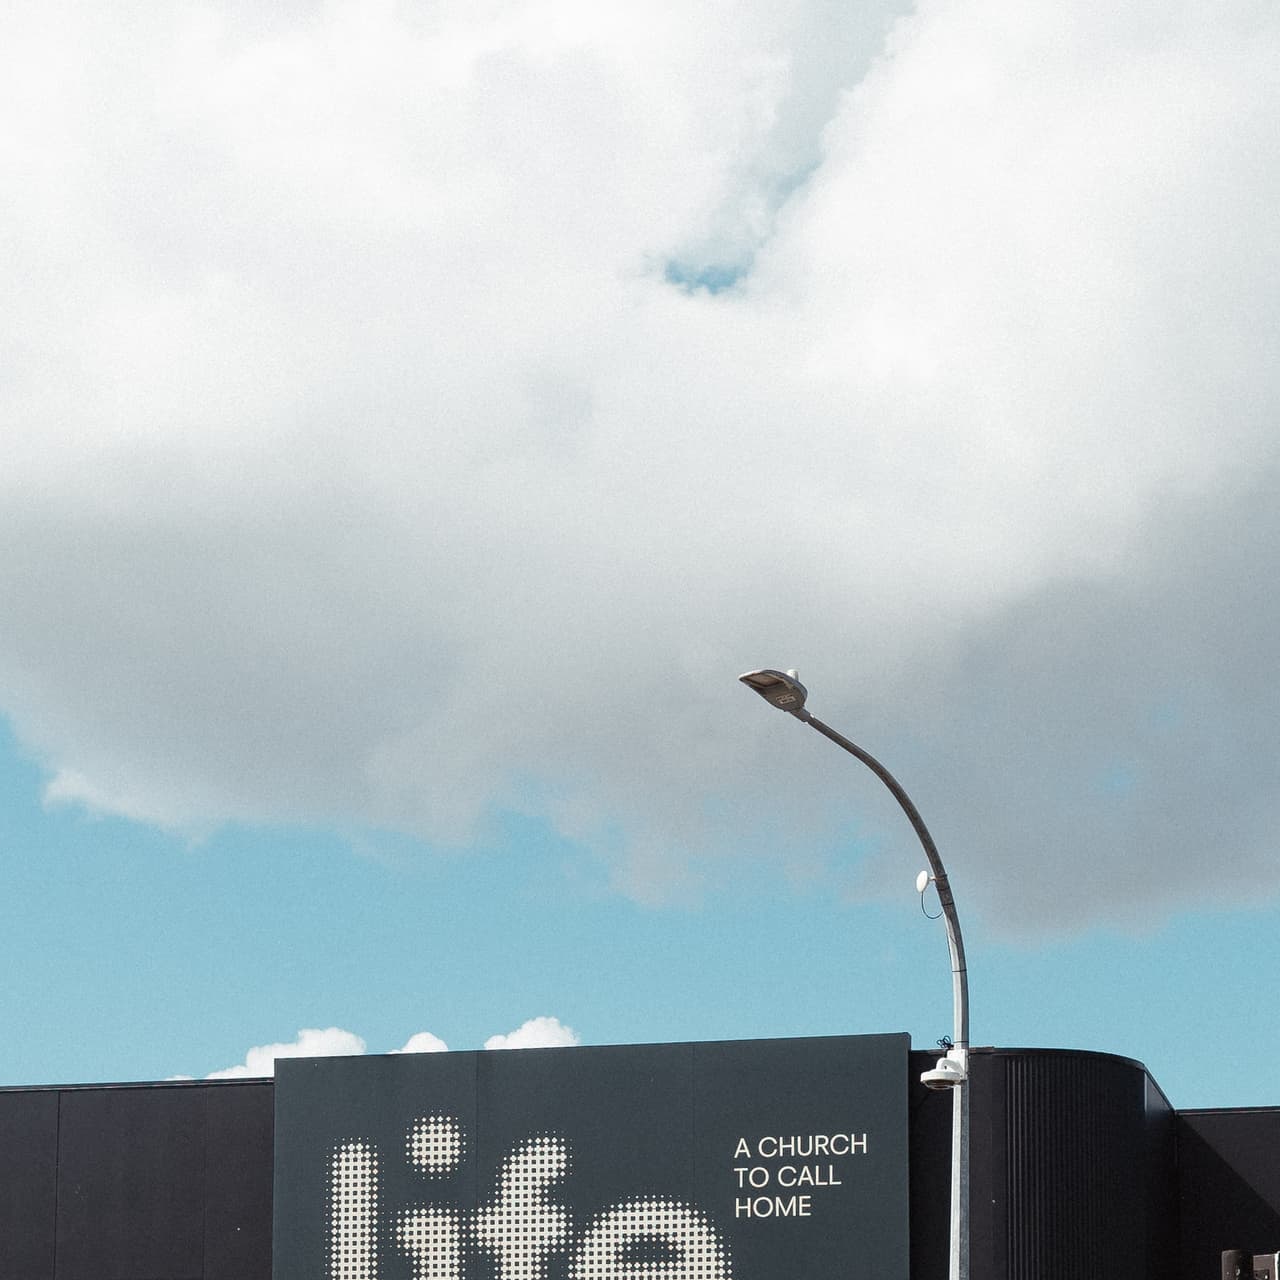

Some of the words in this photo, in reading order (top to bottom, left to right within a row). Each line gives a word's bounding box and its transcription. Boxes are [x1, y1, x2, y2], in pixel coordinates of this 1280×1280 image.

[733, 1137, 751, 1158] A
[758, 1133, 868, 1158] CHURCH
[733, 1166, 770, 1188] TO
[778, 1164, 842, 1187] CALL
[735, 1195, 812, 1218] HOME
